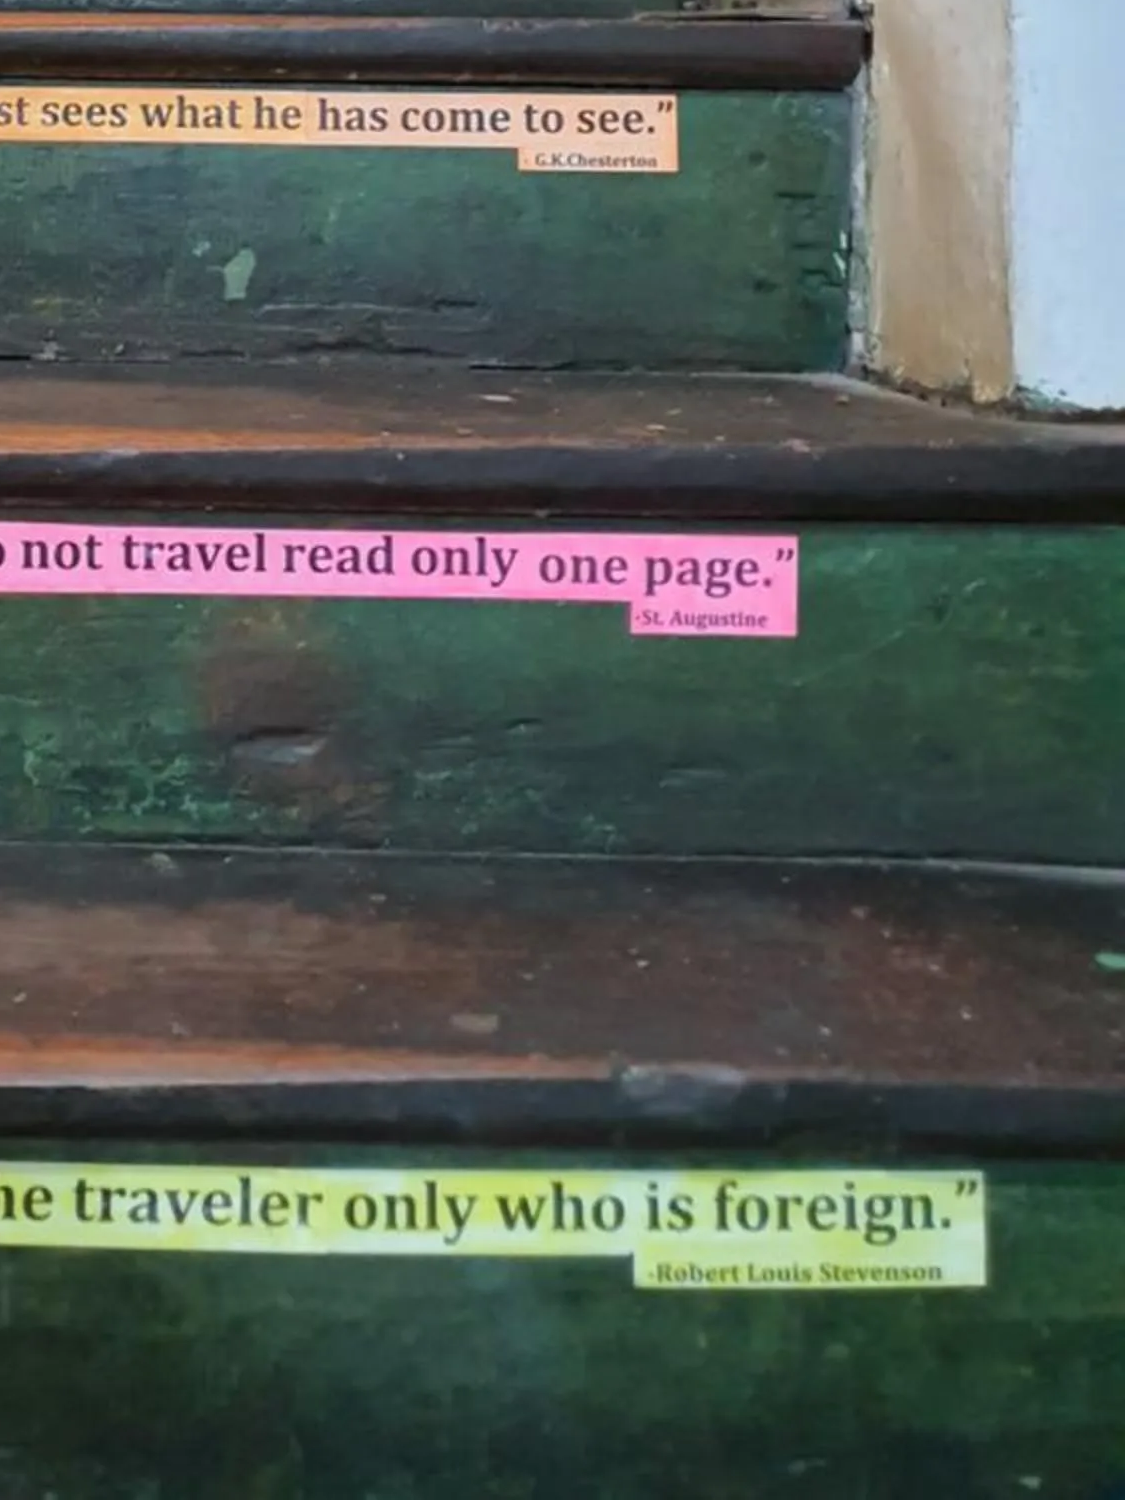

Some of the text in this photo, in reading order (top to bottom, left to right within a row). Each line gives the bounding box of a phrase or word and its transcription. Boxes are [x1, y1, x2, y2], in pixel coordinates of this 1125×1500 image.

[40, 100, 127, 127] sees
[141, 95, 242, 129] what
[254, 96, 302, 129] he
[318, 98, 388, 131] has
[402, 108, 510, 133] come
[523, 105, 563, 134] to
[20, 534, 103, 571] not
[121, 531, 268, 573] travel
[281, 535, 396, 576] read
[410, 535, 519, 588] only
[538, 550, 629, 586] one
[670, 610, 769, 630] Augustine
[73, 1176, 324, 1228] traveler
[342, 1180, 477, 1245] only
[496, 1180, 626, 1231] who
[645, 1180, 694, 1232] is
[713, 1180, 977, 1244] foreign.”
[745, 1263, 813, 1283] Louis
[819, 1263, 943, 1283] Stevenson
